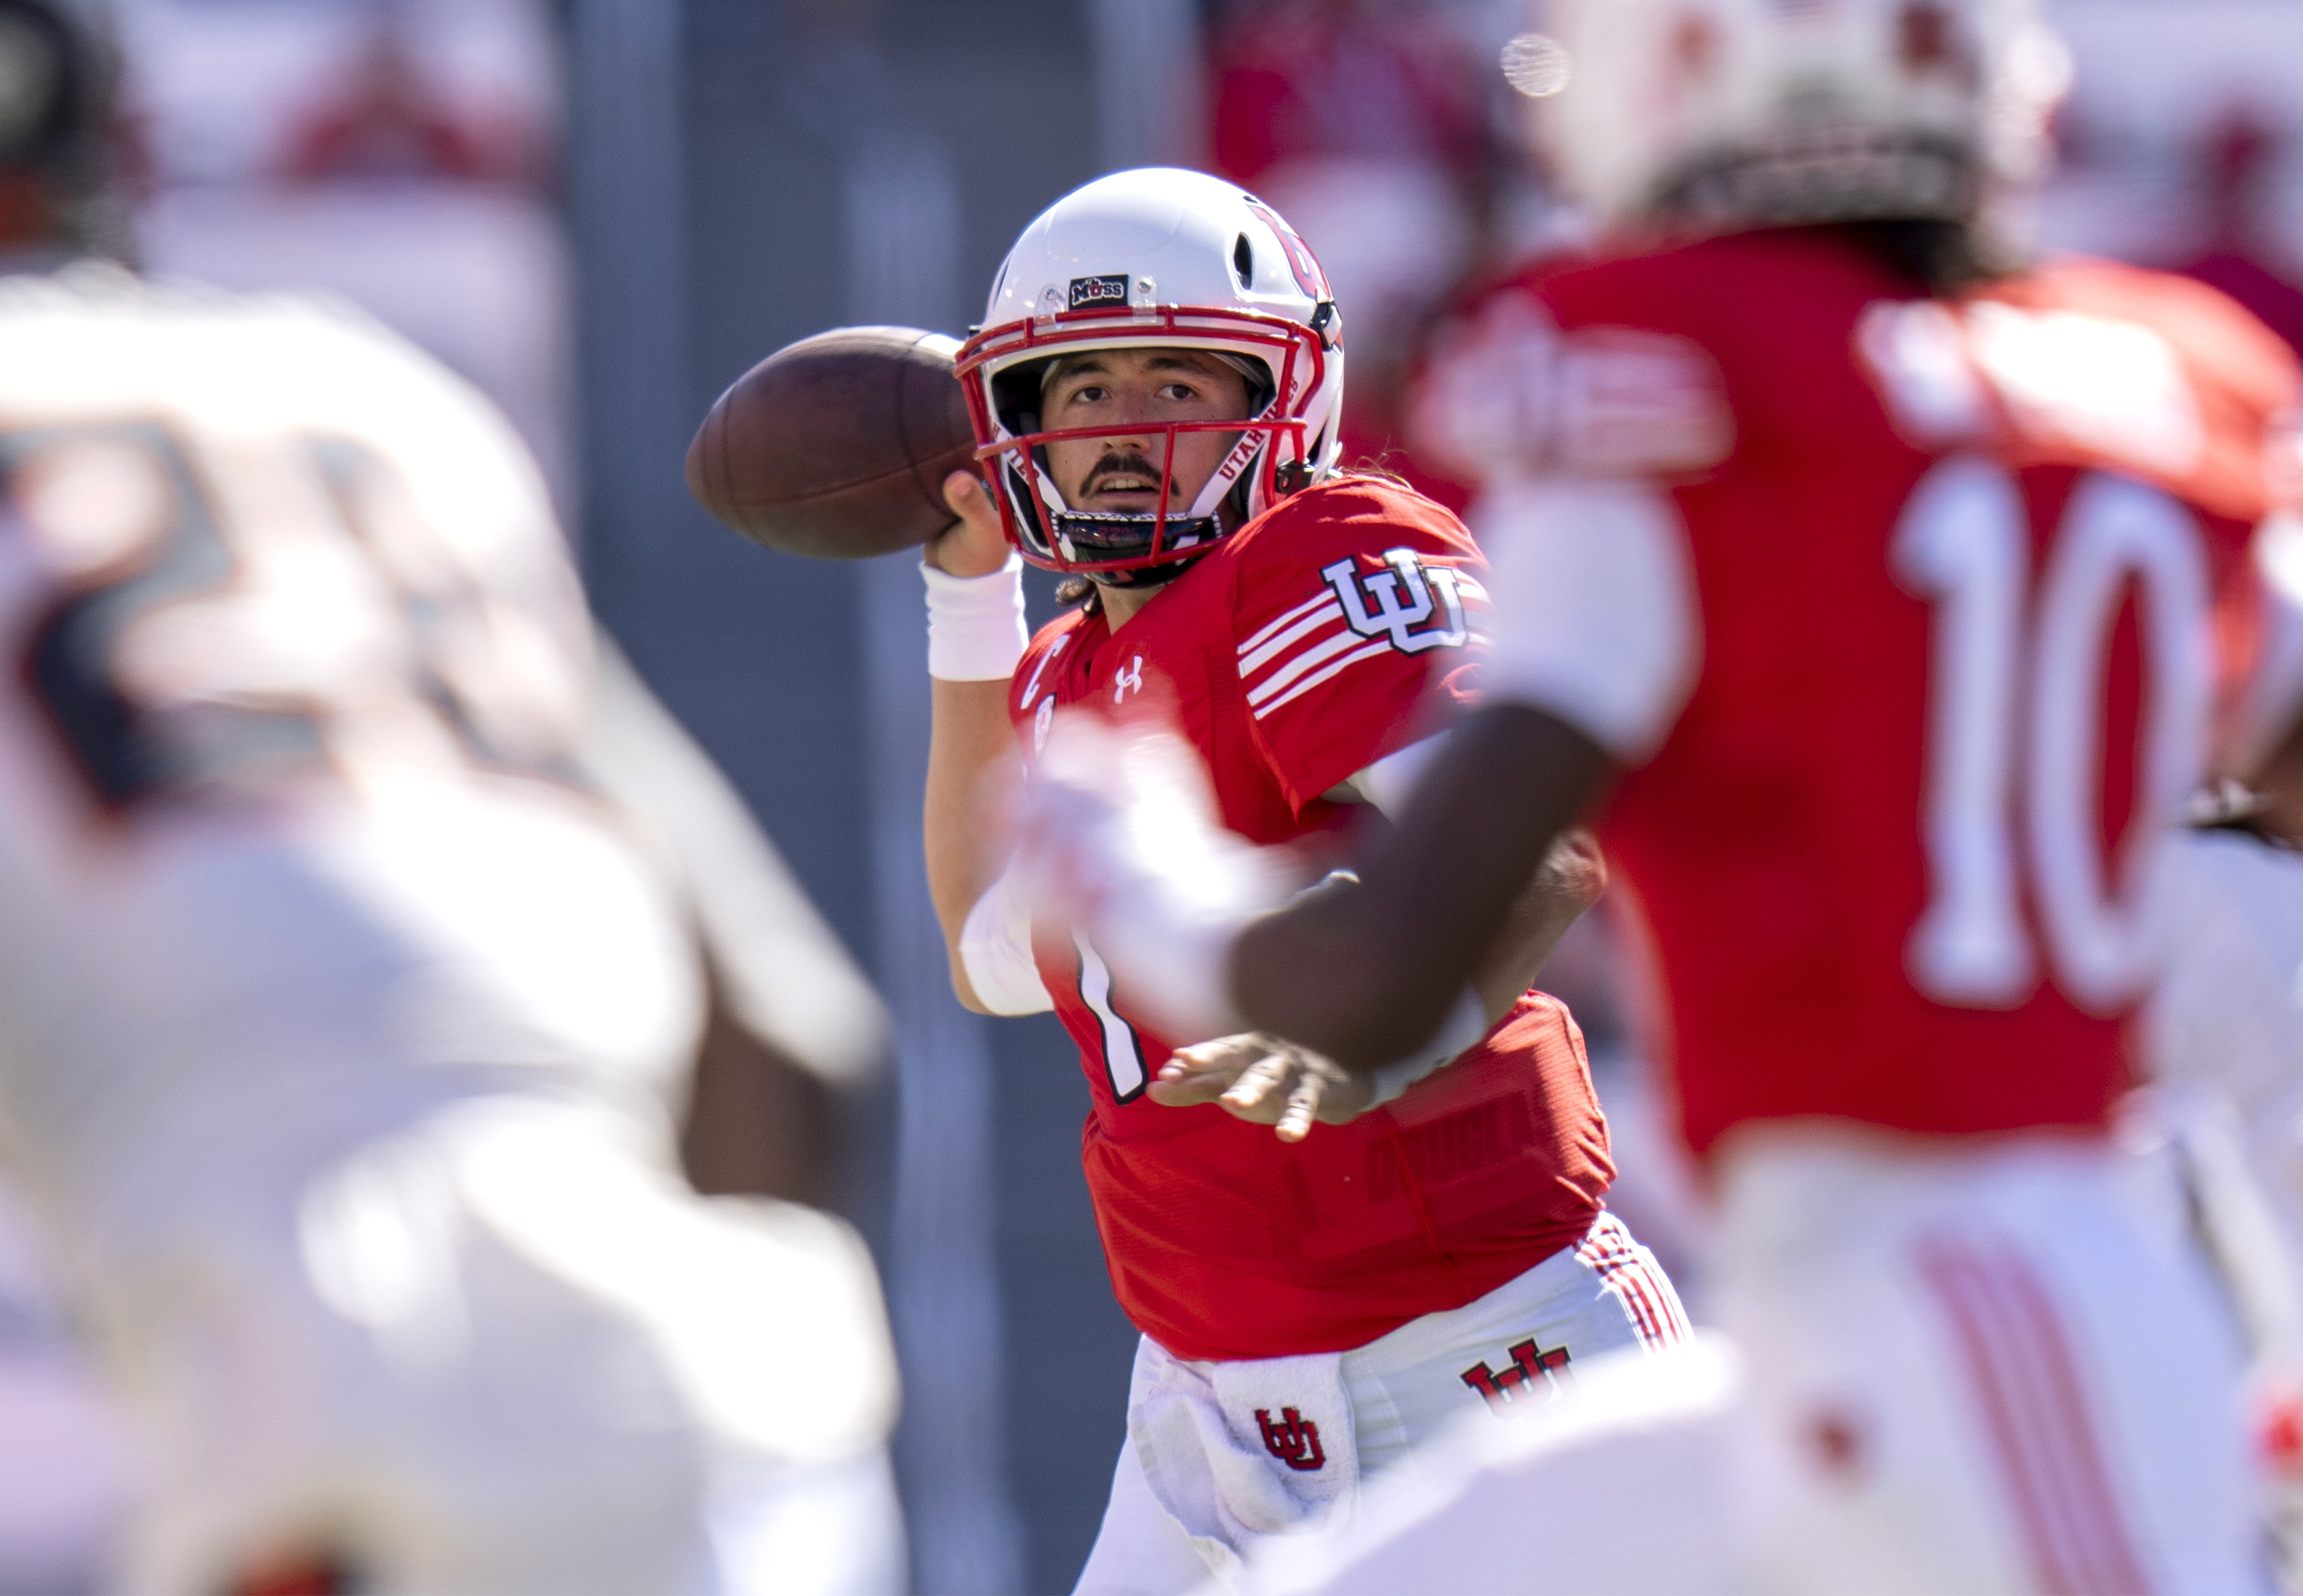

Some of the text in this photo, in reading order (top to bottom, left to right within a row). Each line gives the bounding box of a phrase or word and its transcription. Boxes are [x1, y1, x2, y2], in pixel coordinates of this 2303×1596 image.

[1072, 278, 1124, 306] MUSS
[1218, 428, 1266, 481] UTAH
[1887, 452, 2216, 1020] 10
